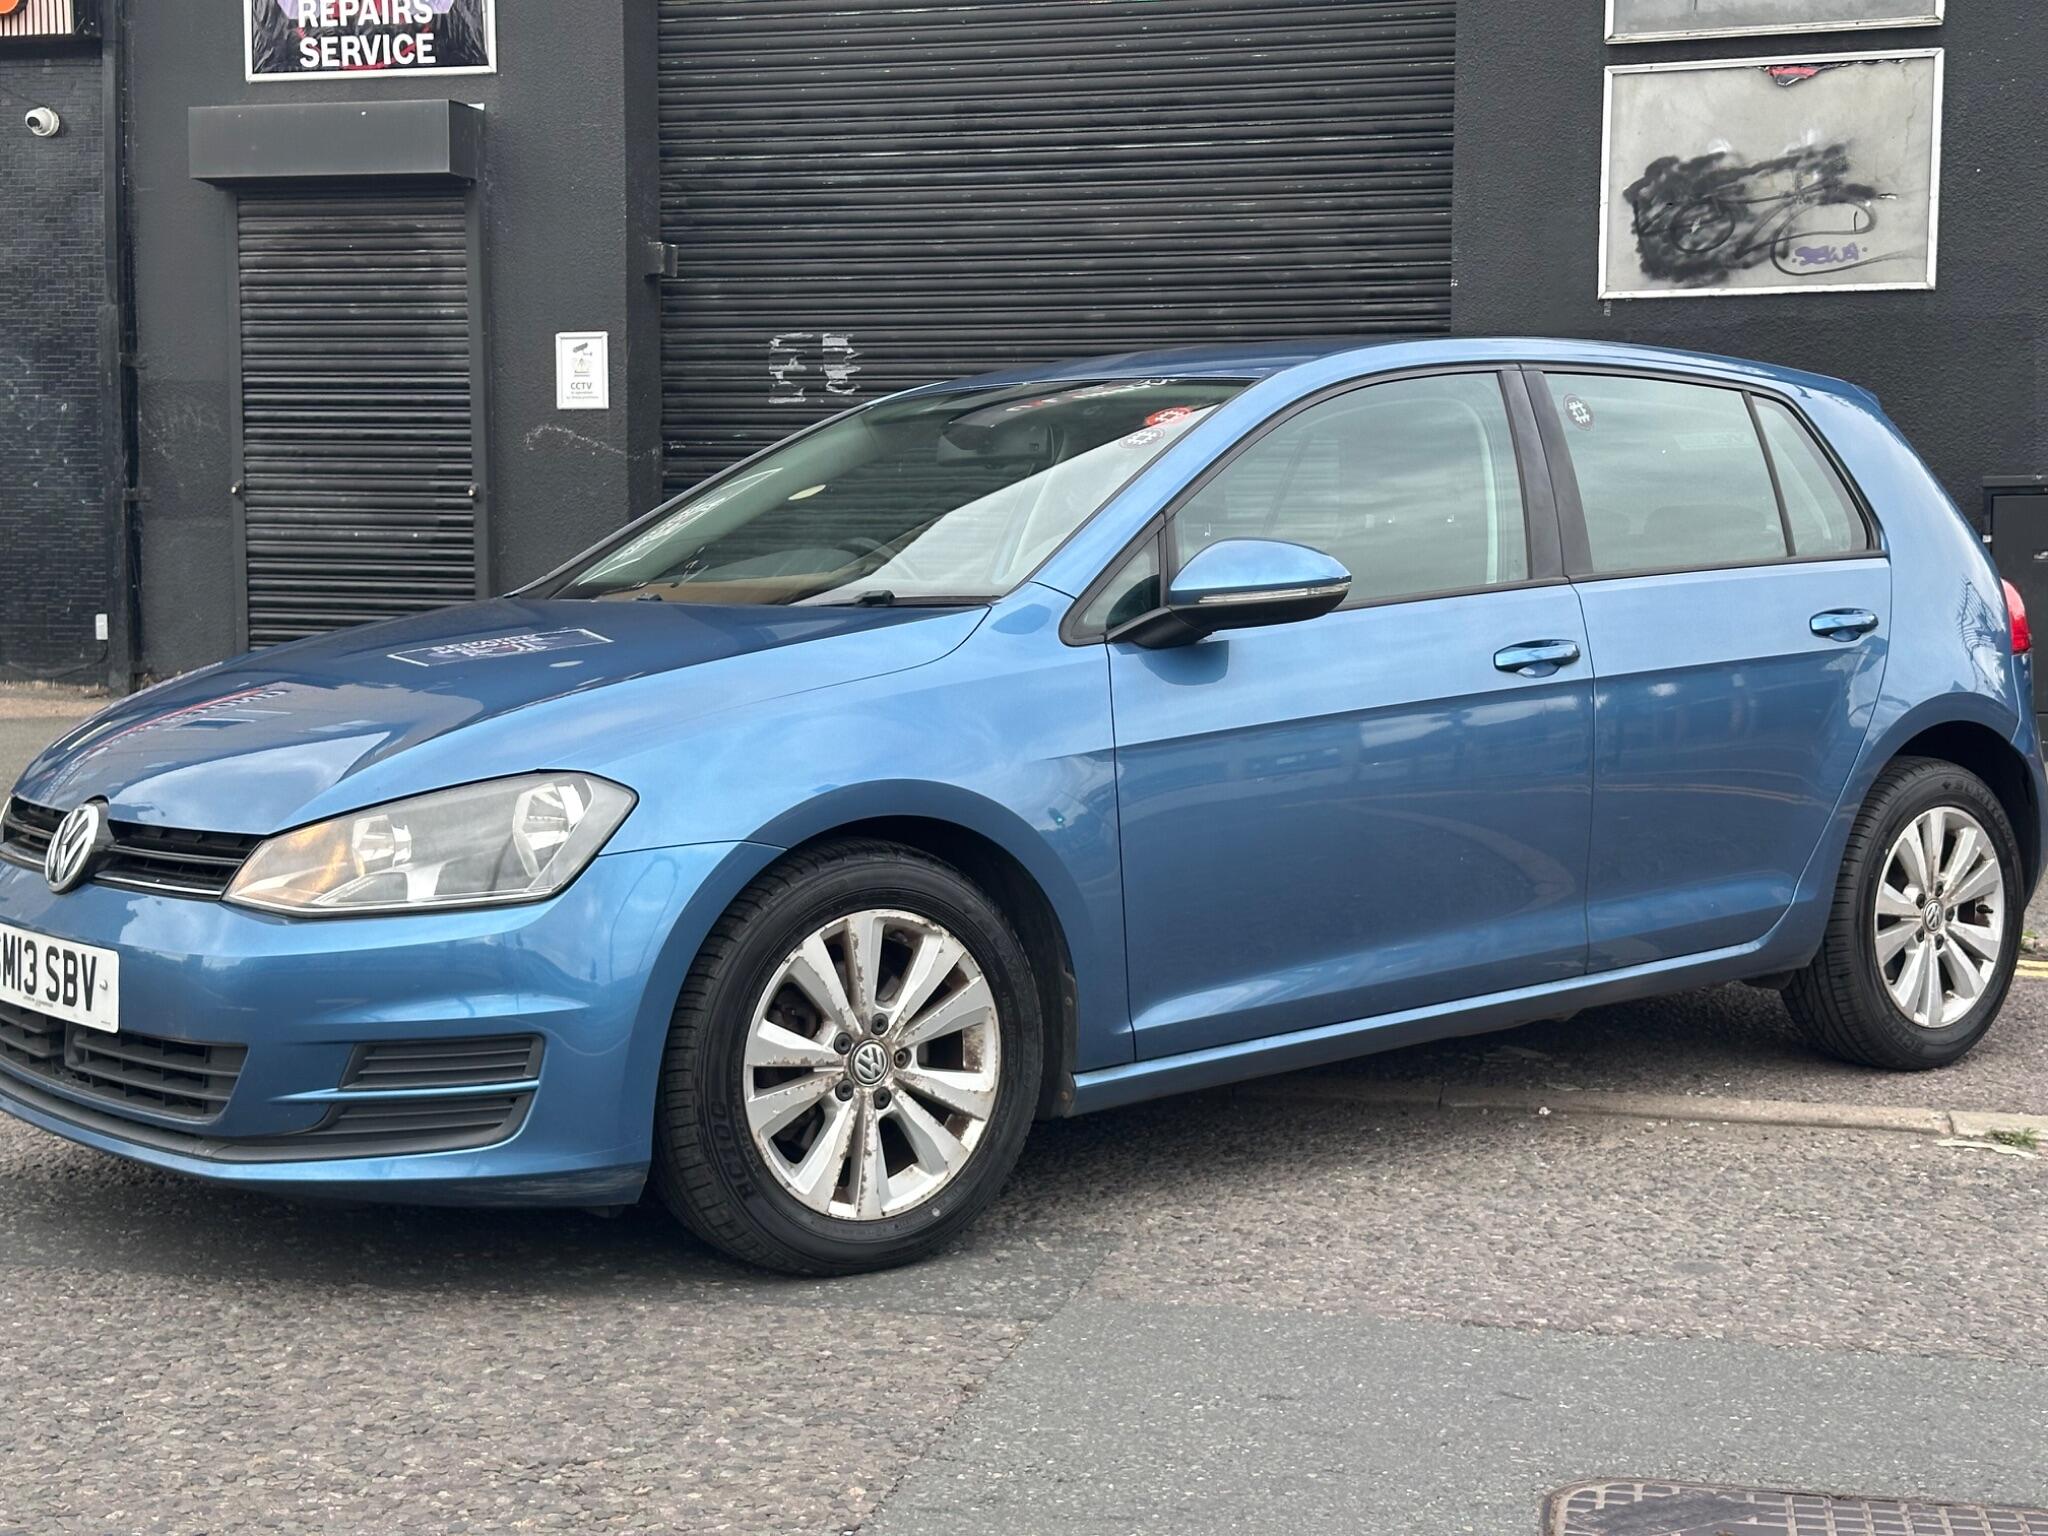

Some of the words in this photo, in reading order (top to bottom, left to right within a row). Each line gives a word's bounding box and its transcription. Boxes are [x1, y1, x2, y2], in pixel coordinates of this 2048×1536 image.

[298, 0, 433, 27] REPAIRS
[300, 33, 436, 67] SERVICE
[570, 382, 592, 390] CCTV
[0, 932, 38, 995] M13
[46, 945, 97, 1012] SBV
